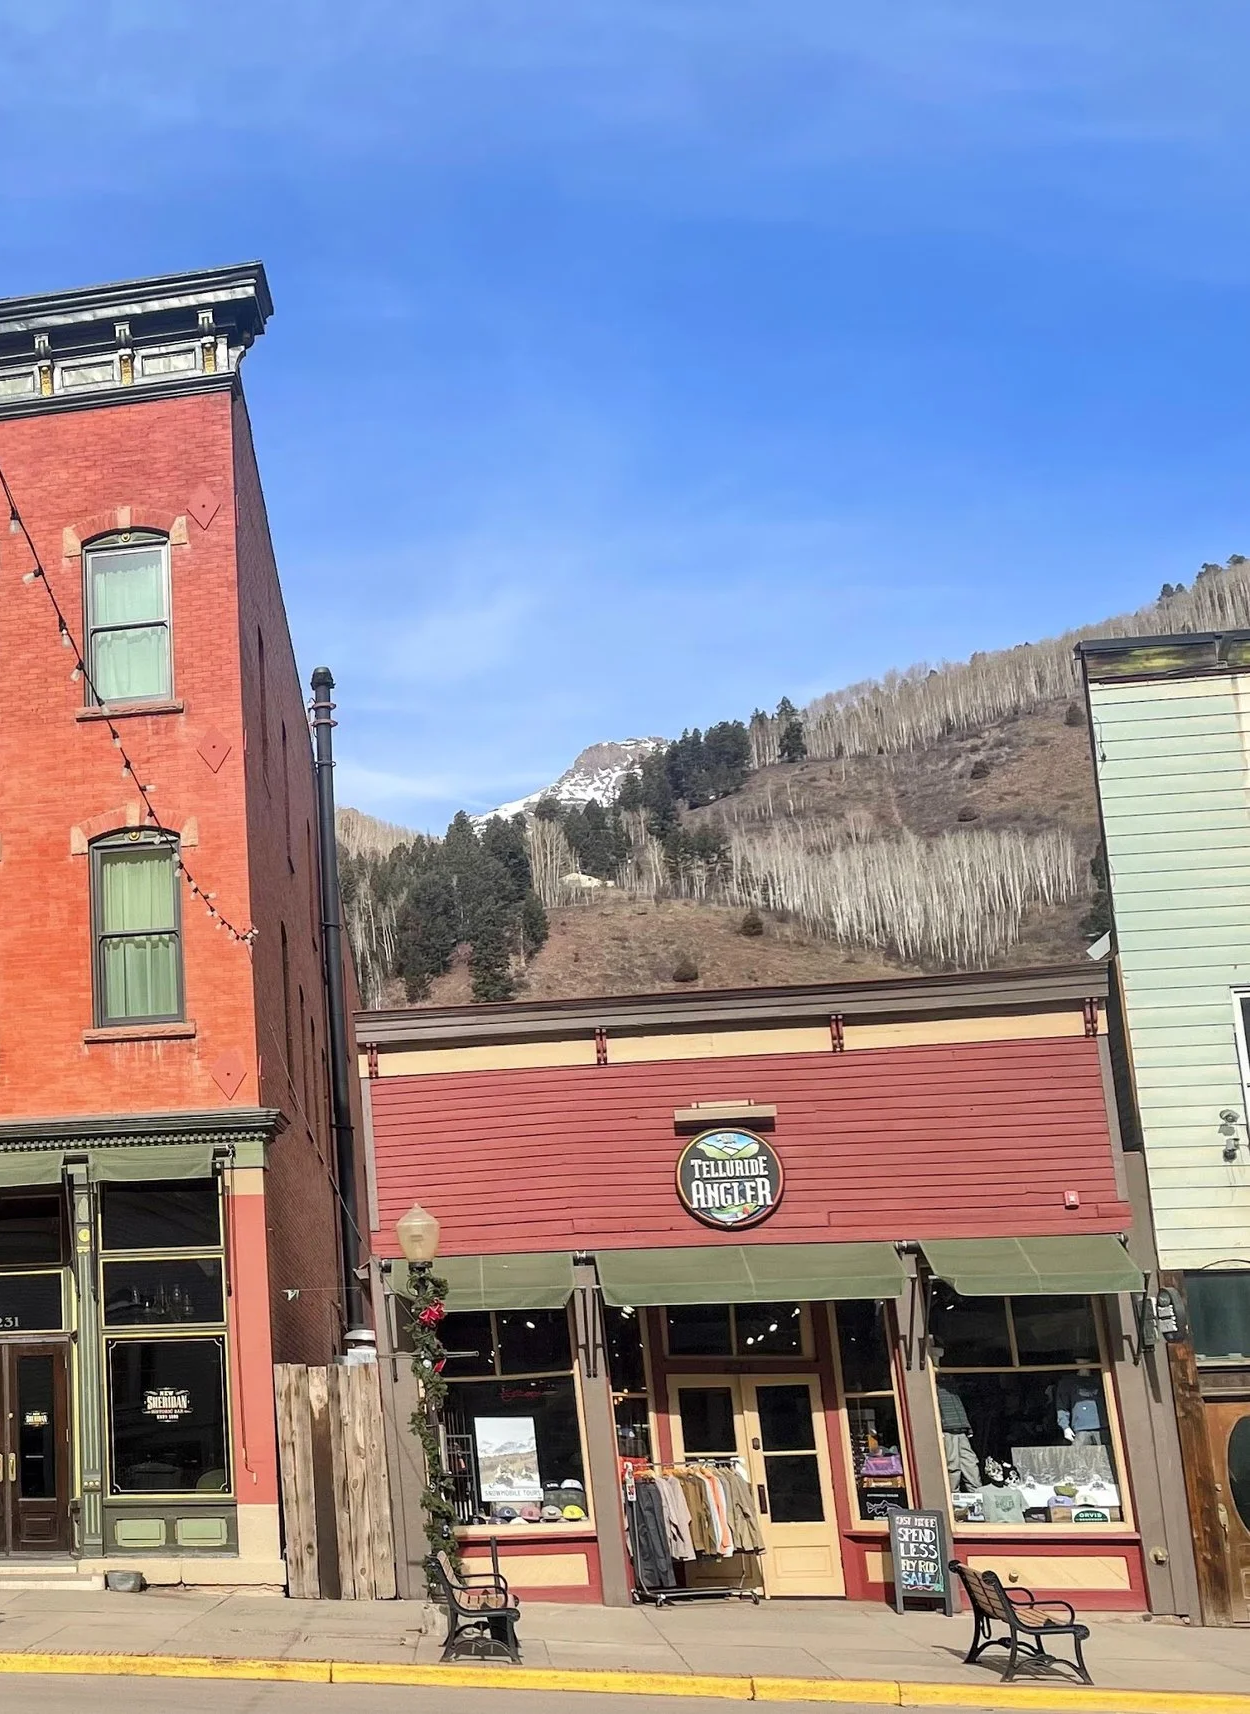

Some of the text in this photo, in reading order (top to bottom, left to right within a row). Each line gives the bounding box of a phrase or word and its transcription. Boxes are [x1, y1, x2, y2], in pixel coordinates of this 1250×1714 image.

[690, 1156, 769, 1178] TELLURIDE
[691, 1178, 774, 1209] ANGLER
[146, 1395, 188, 1410] SHERIDAN
[484, 1488, 541, 1497] SNOWMOBILE TOURS
[897, 1527, 936, 1543] SPEND
[899, 1542, 938, 1559] LESS
[901, 1559, 938, 1573] FLY ROD
[901, 1571, 935, 1586] SALE
